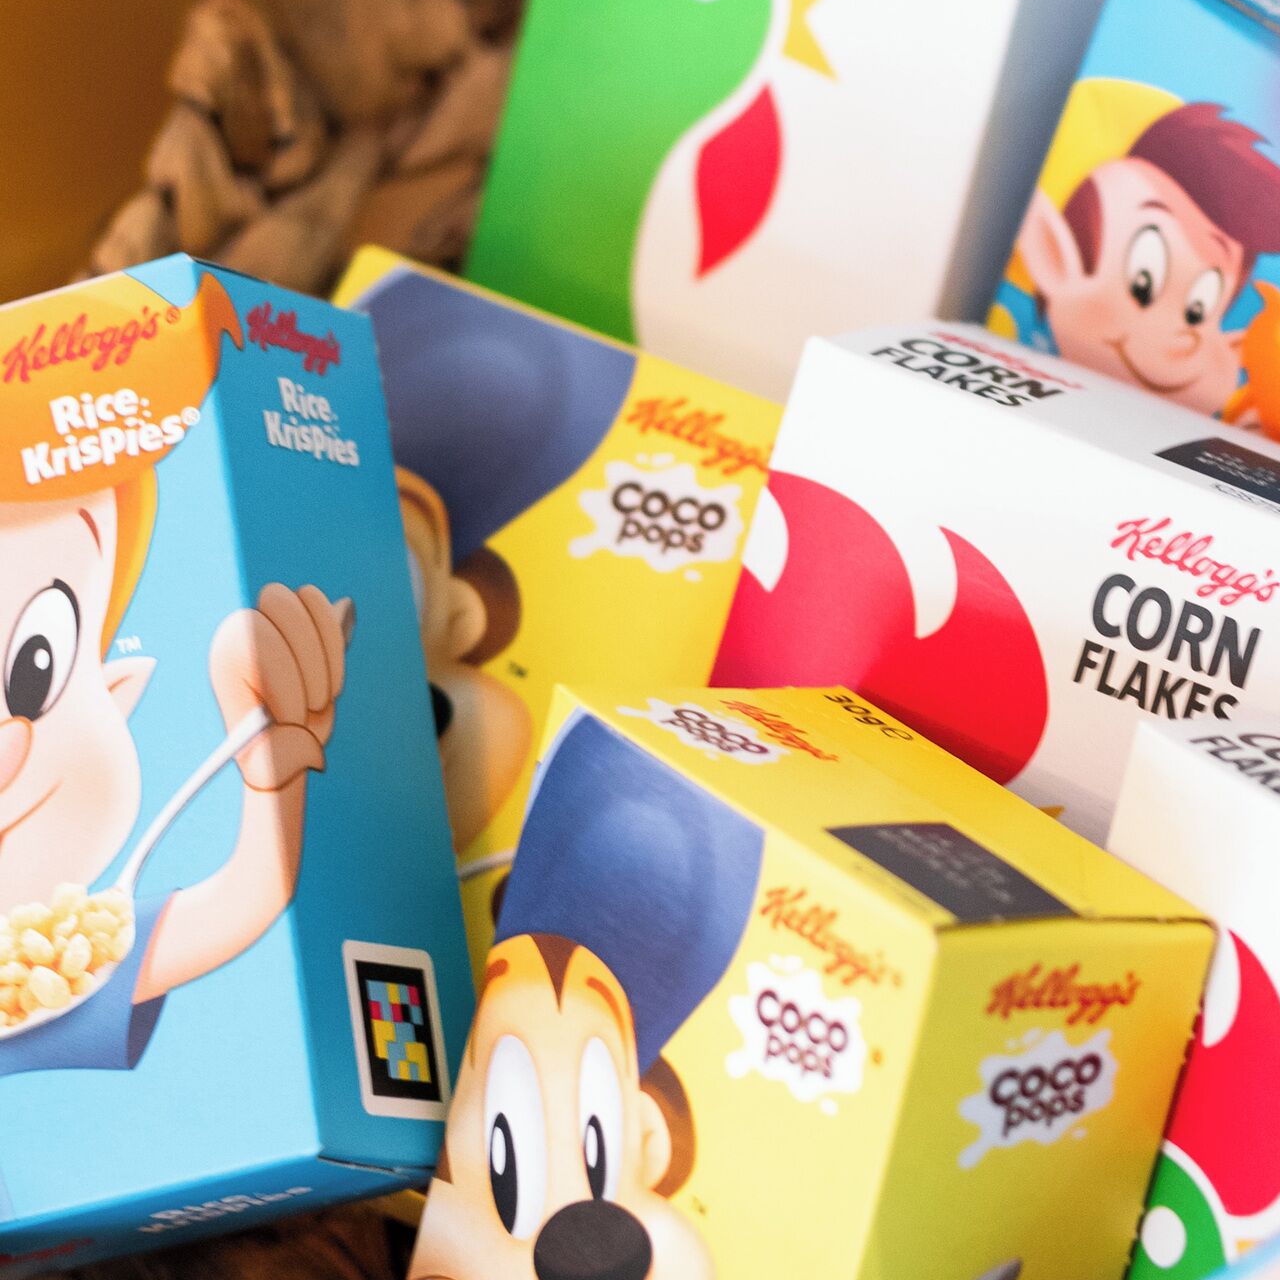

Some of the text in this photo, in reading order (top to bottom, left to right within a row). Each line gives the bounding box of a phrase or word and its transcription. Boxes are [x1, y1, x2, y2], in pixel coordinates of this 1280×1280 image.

[870, 347, 1032, 407] FLAKES
[901, 339, 1065, 399] CORN
[50, 388, 139, 435] Rice
[277, 377, 331, 423] Rice
[20, 416, 185, 485] Krispies
[263, 409, 360, 466] Krispies
[627, 397, 770, 477] Kellogg
[1092, 573, 1261, 690] CORN
[1073, 639, 1239, 720] FLAKES
